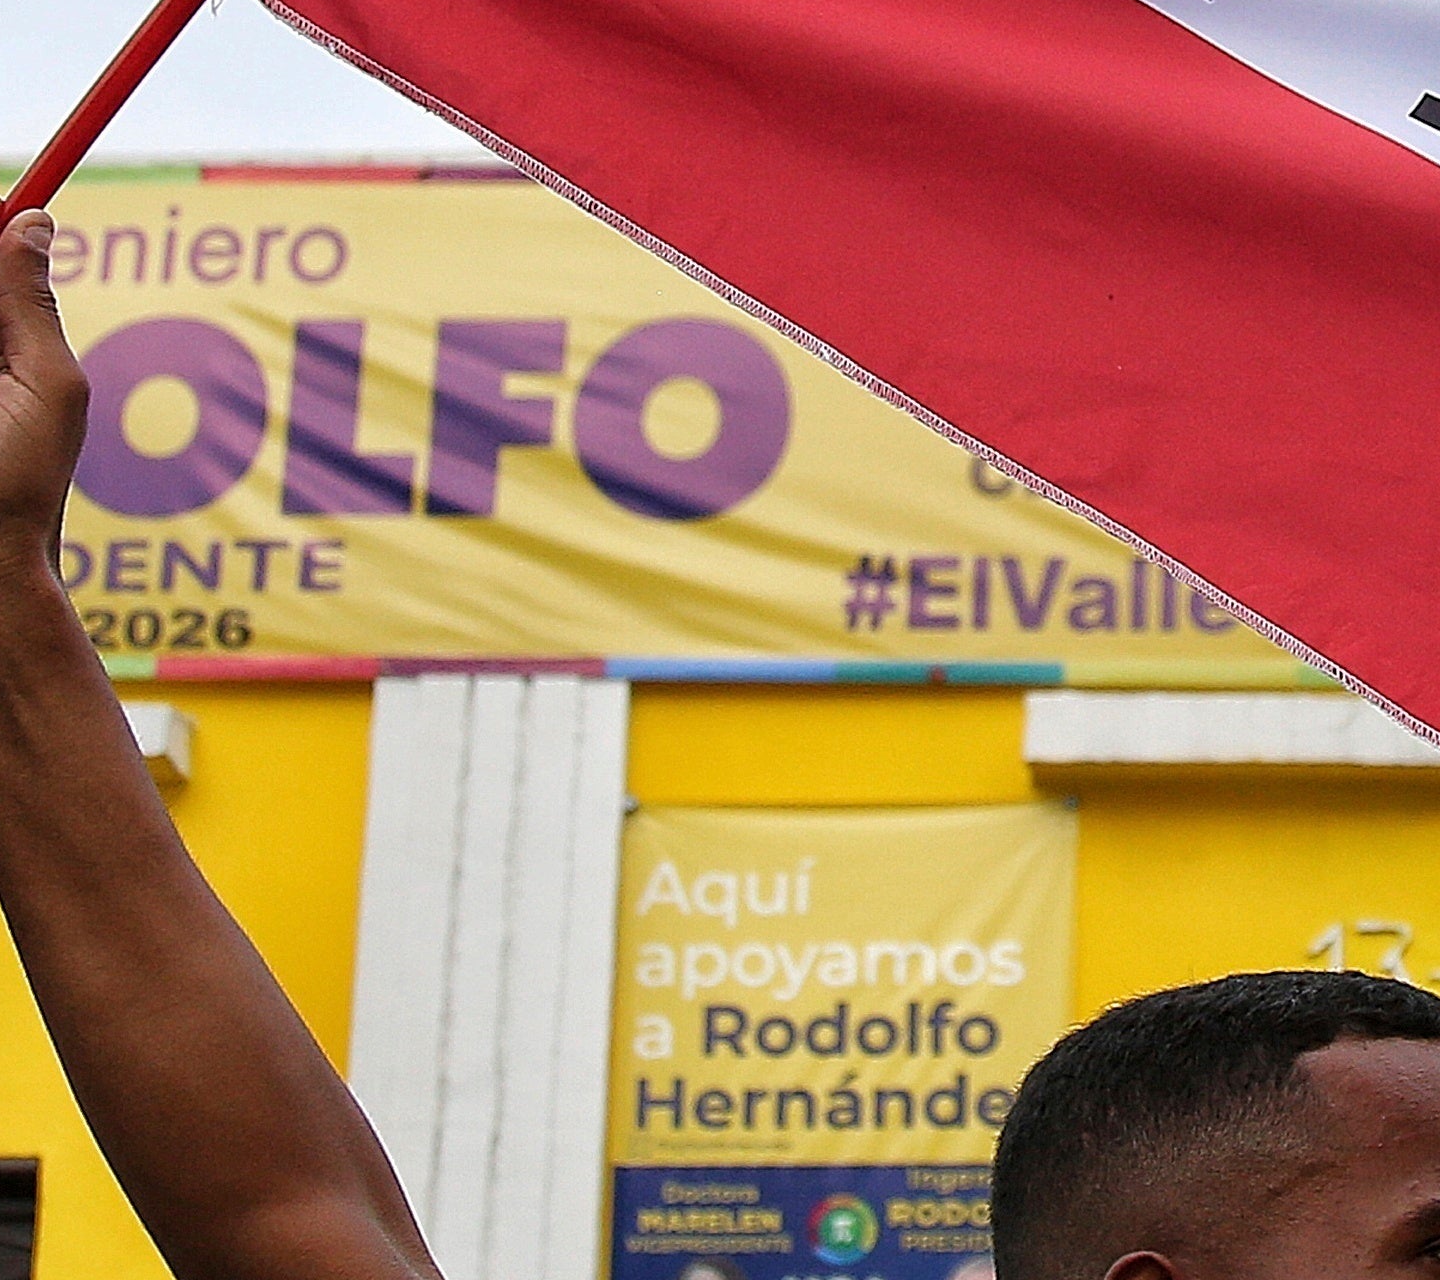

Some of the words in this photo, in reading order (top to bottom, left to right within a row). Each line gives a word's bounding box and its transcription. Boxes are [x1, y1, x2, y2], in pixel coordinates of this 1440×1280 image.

[87, 608, 253, 650] 2026
[635, 856, 818, 928] Aquí
[634, 936, 1026, 1002] apoyamos
[633, 1016, 674, 1060] a
[702, 1000, 1001, 1058] Rodolfo
[636, 1070, 1016, 1132] Hernánde
[886, 1198, 992, 1228] RODO
